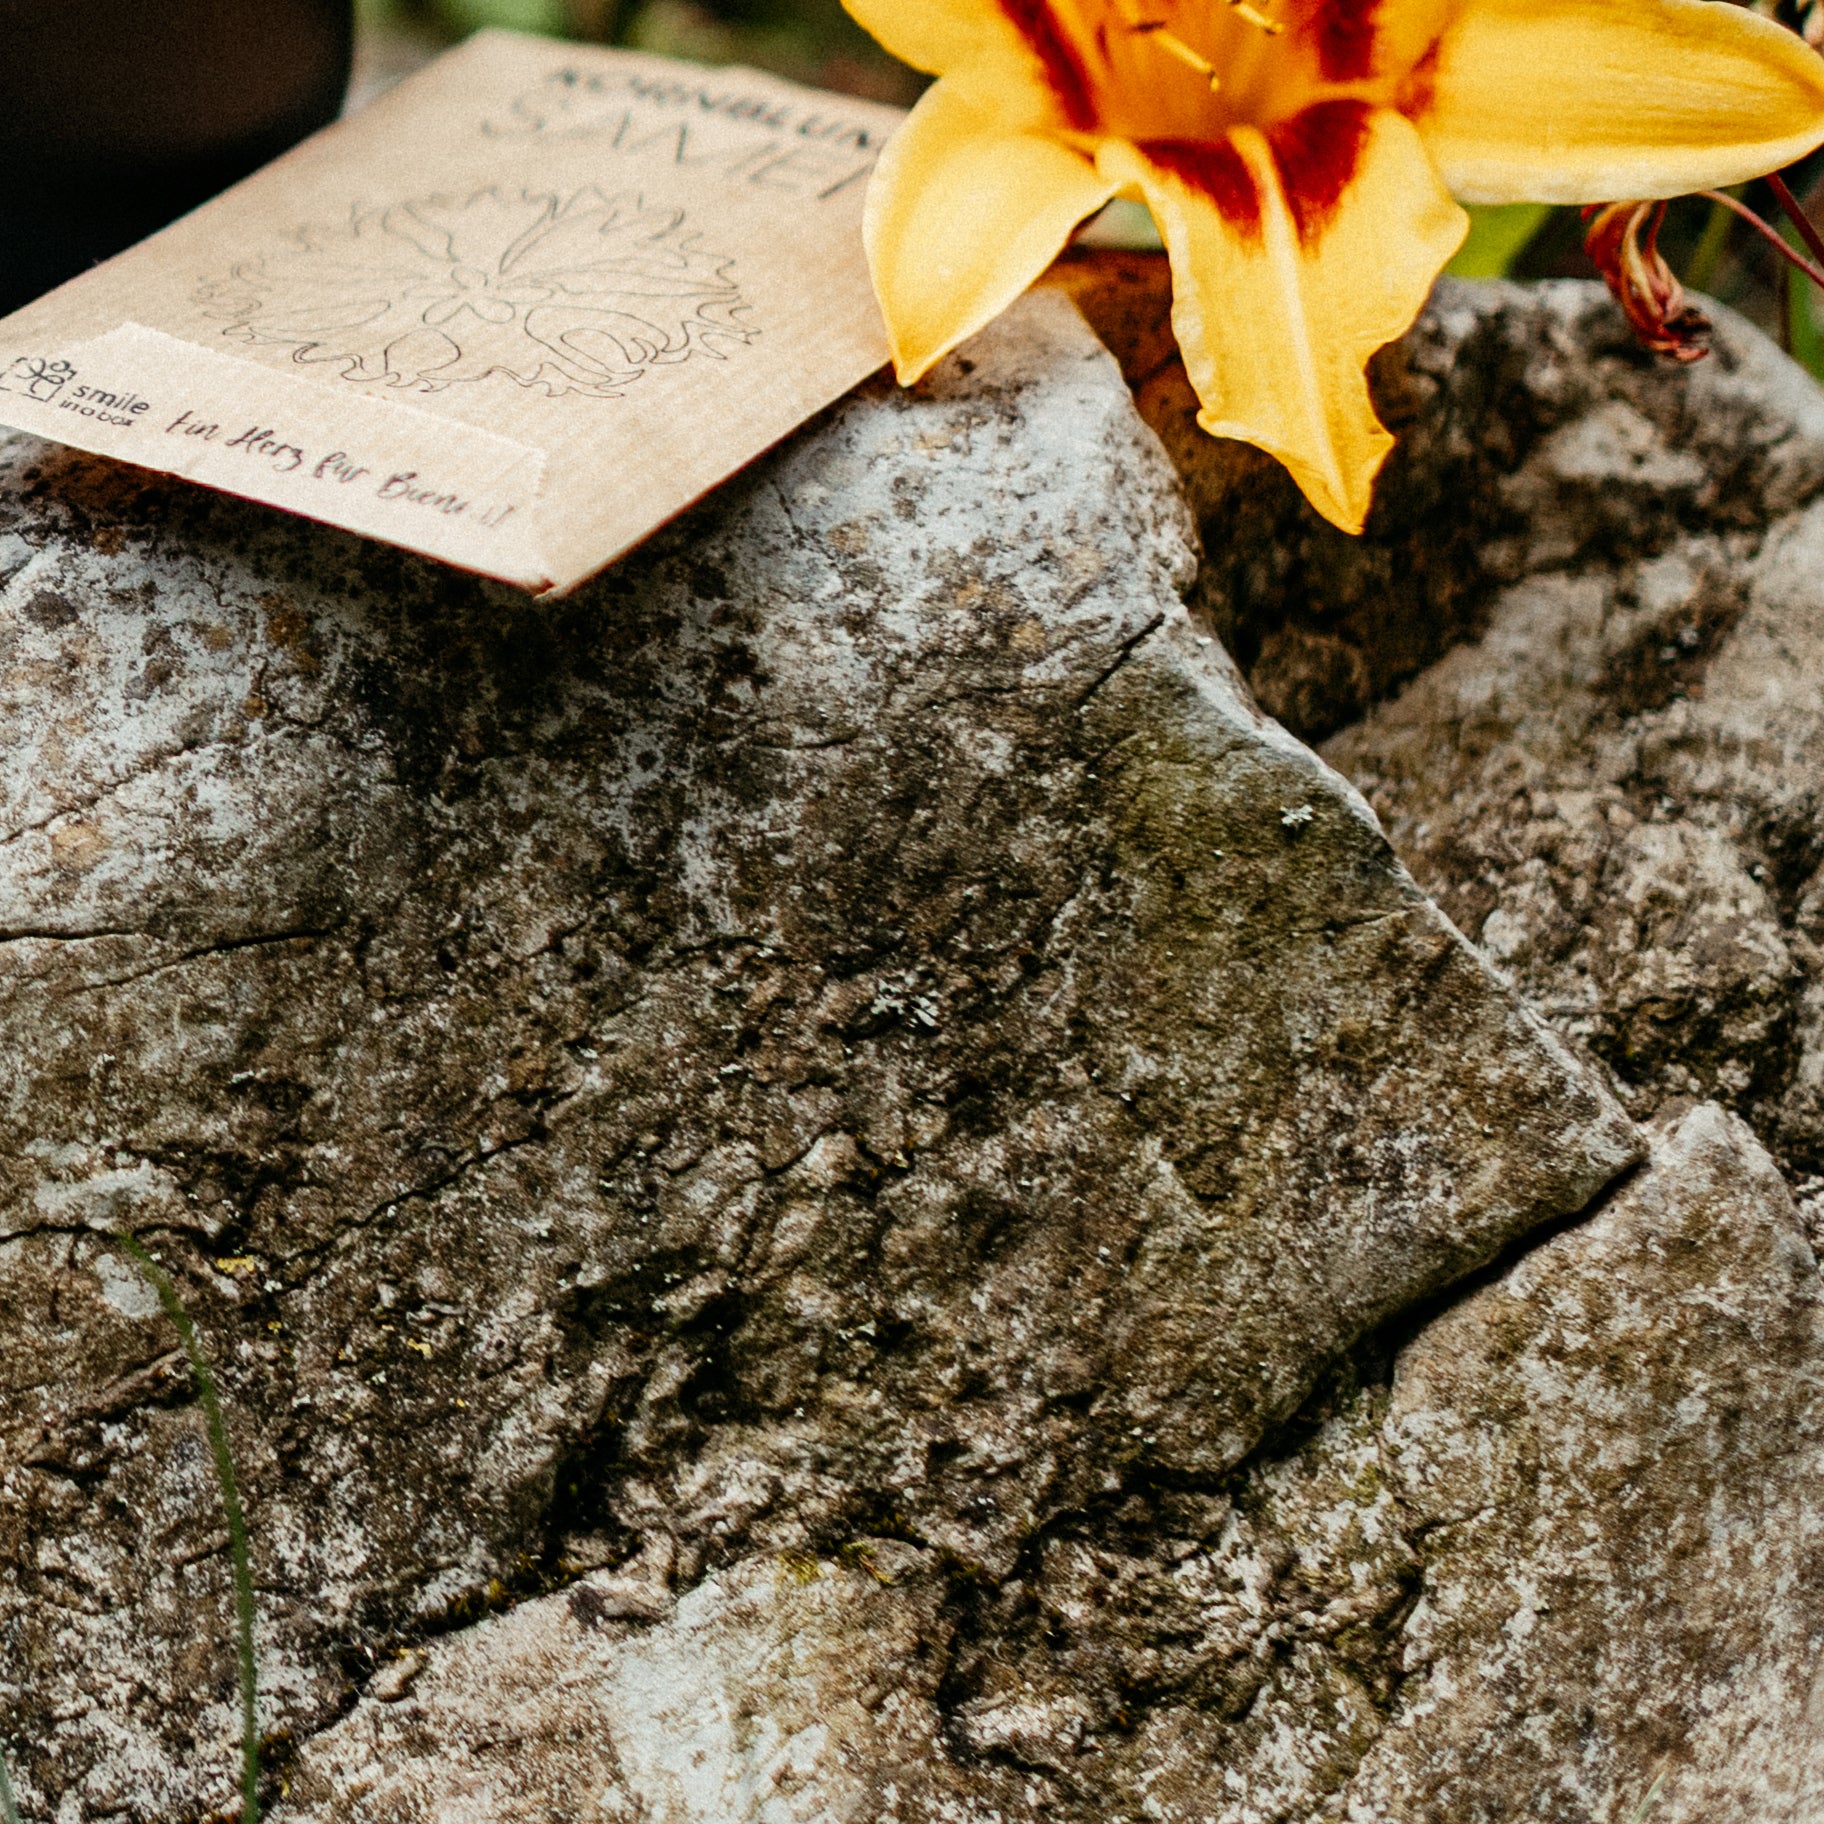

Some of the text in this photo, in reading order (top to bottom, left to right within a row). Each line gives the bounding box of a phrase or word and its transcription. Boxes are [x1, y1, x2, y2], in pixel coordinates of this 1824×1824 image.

[478, 93, 878, 202] SAME
[72, 384, 150, 415] smile
[224, 425, 303, 473] Herz
